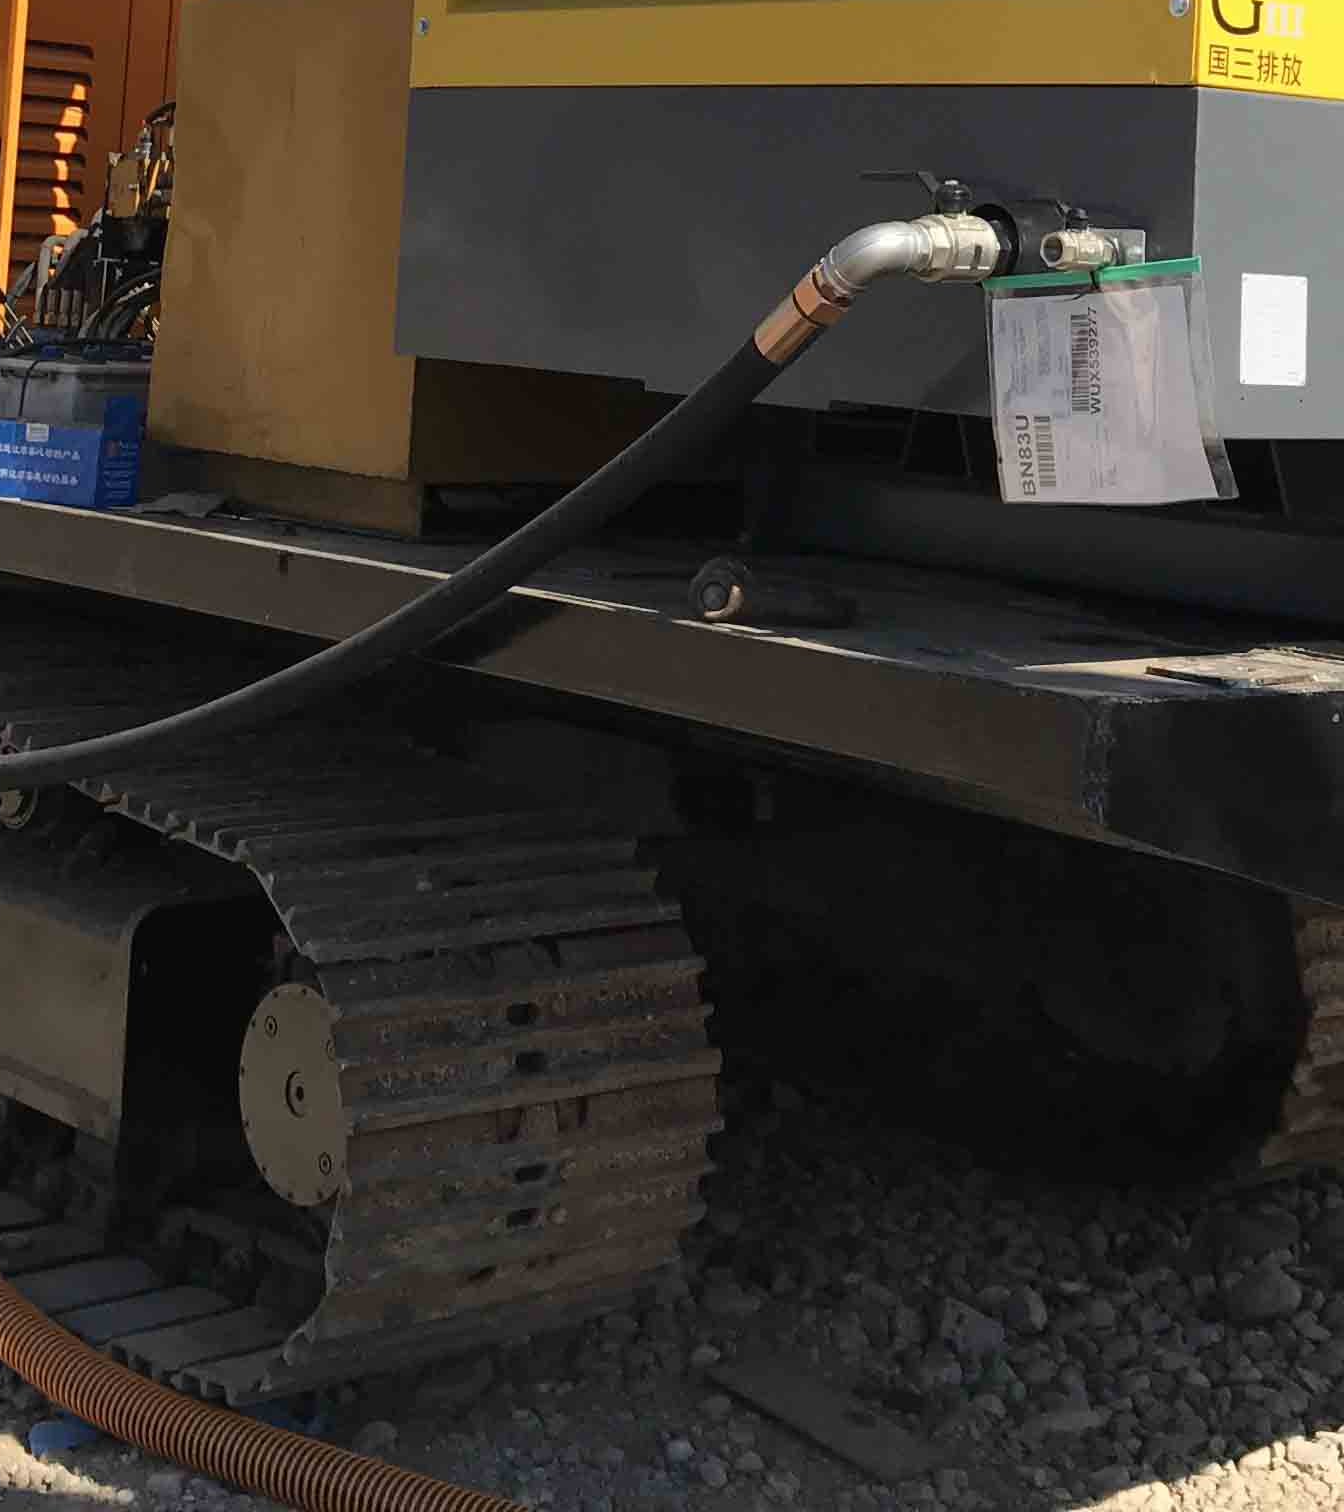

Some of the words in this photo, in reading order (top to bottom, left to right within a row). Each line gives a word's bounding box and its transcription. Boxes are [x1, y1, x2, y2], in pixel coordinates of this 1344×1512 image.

[1208, 44, 1304, 88] 国三排放
[1087, 306, 1102, 415] WUX539277
[1015, 414, 1037, 496] BN83U
